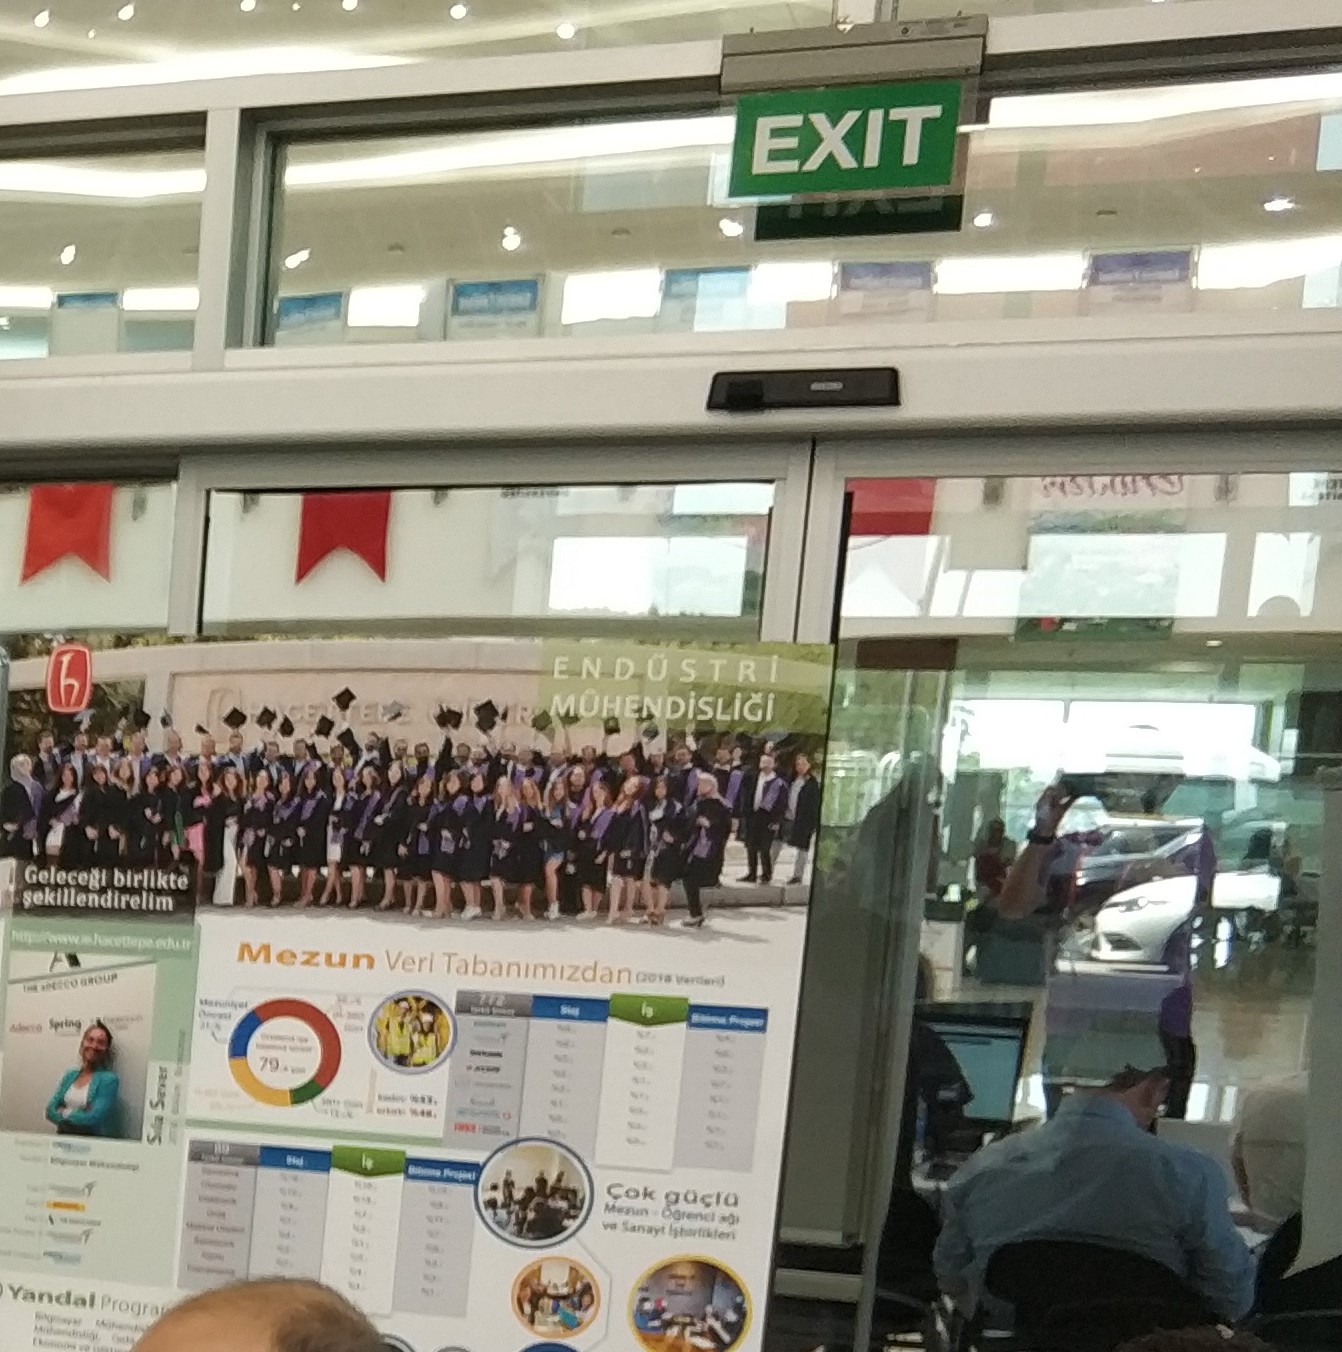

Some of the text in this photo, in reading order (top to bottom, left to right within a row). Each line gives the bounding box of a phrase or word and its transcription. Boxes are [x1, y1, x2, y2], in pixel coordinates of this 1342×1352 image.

[751, 104, 944, 176] EXIT
[553, 654, 779, 684] ENDÜSTRİ
[550, 688, 776, 722] MÜHENDİSLİĞİ
[25, 865, 189, 891] Geleceği birlikte
[23, 887, 174, 912] şekillendirelim
[236, 941, 376, 970] Mezun
[384, 949, 435, 975] Veri
[442, 951, 632, 985] Tabanımızdan
[606, 1183, 739, 1208] Çok güçlü
[8, 1283, 95, 1309] Yandal
